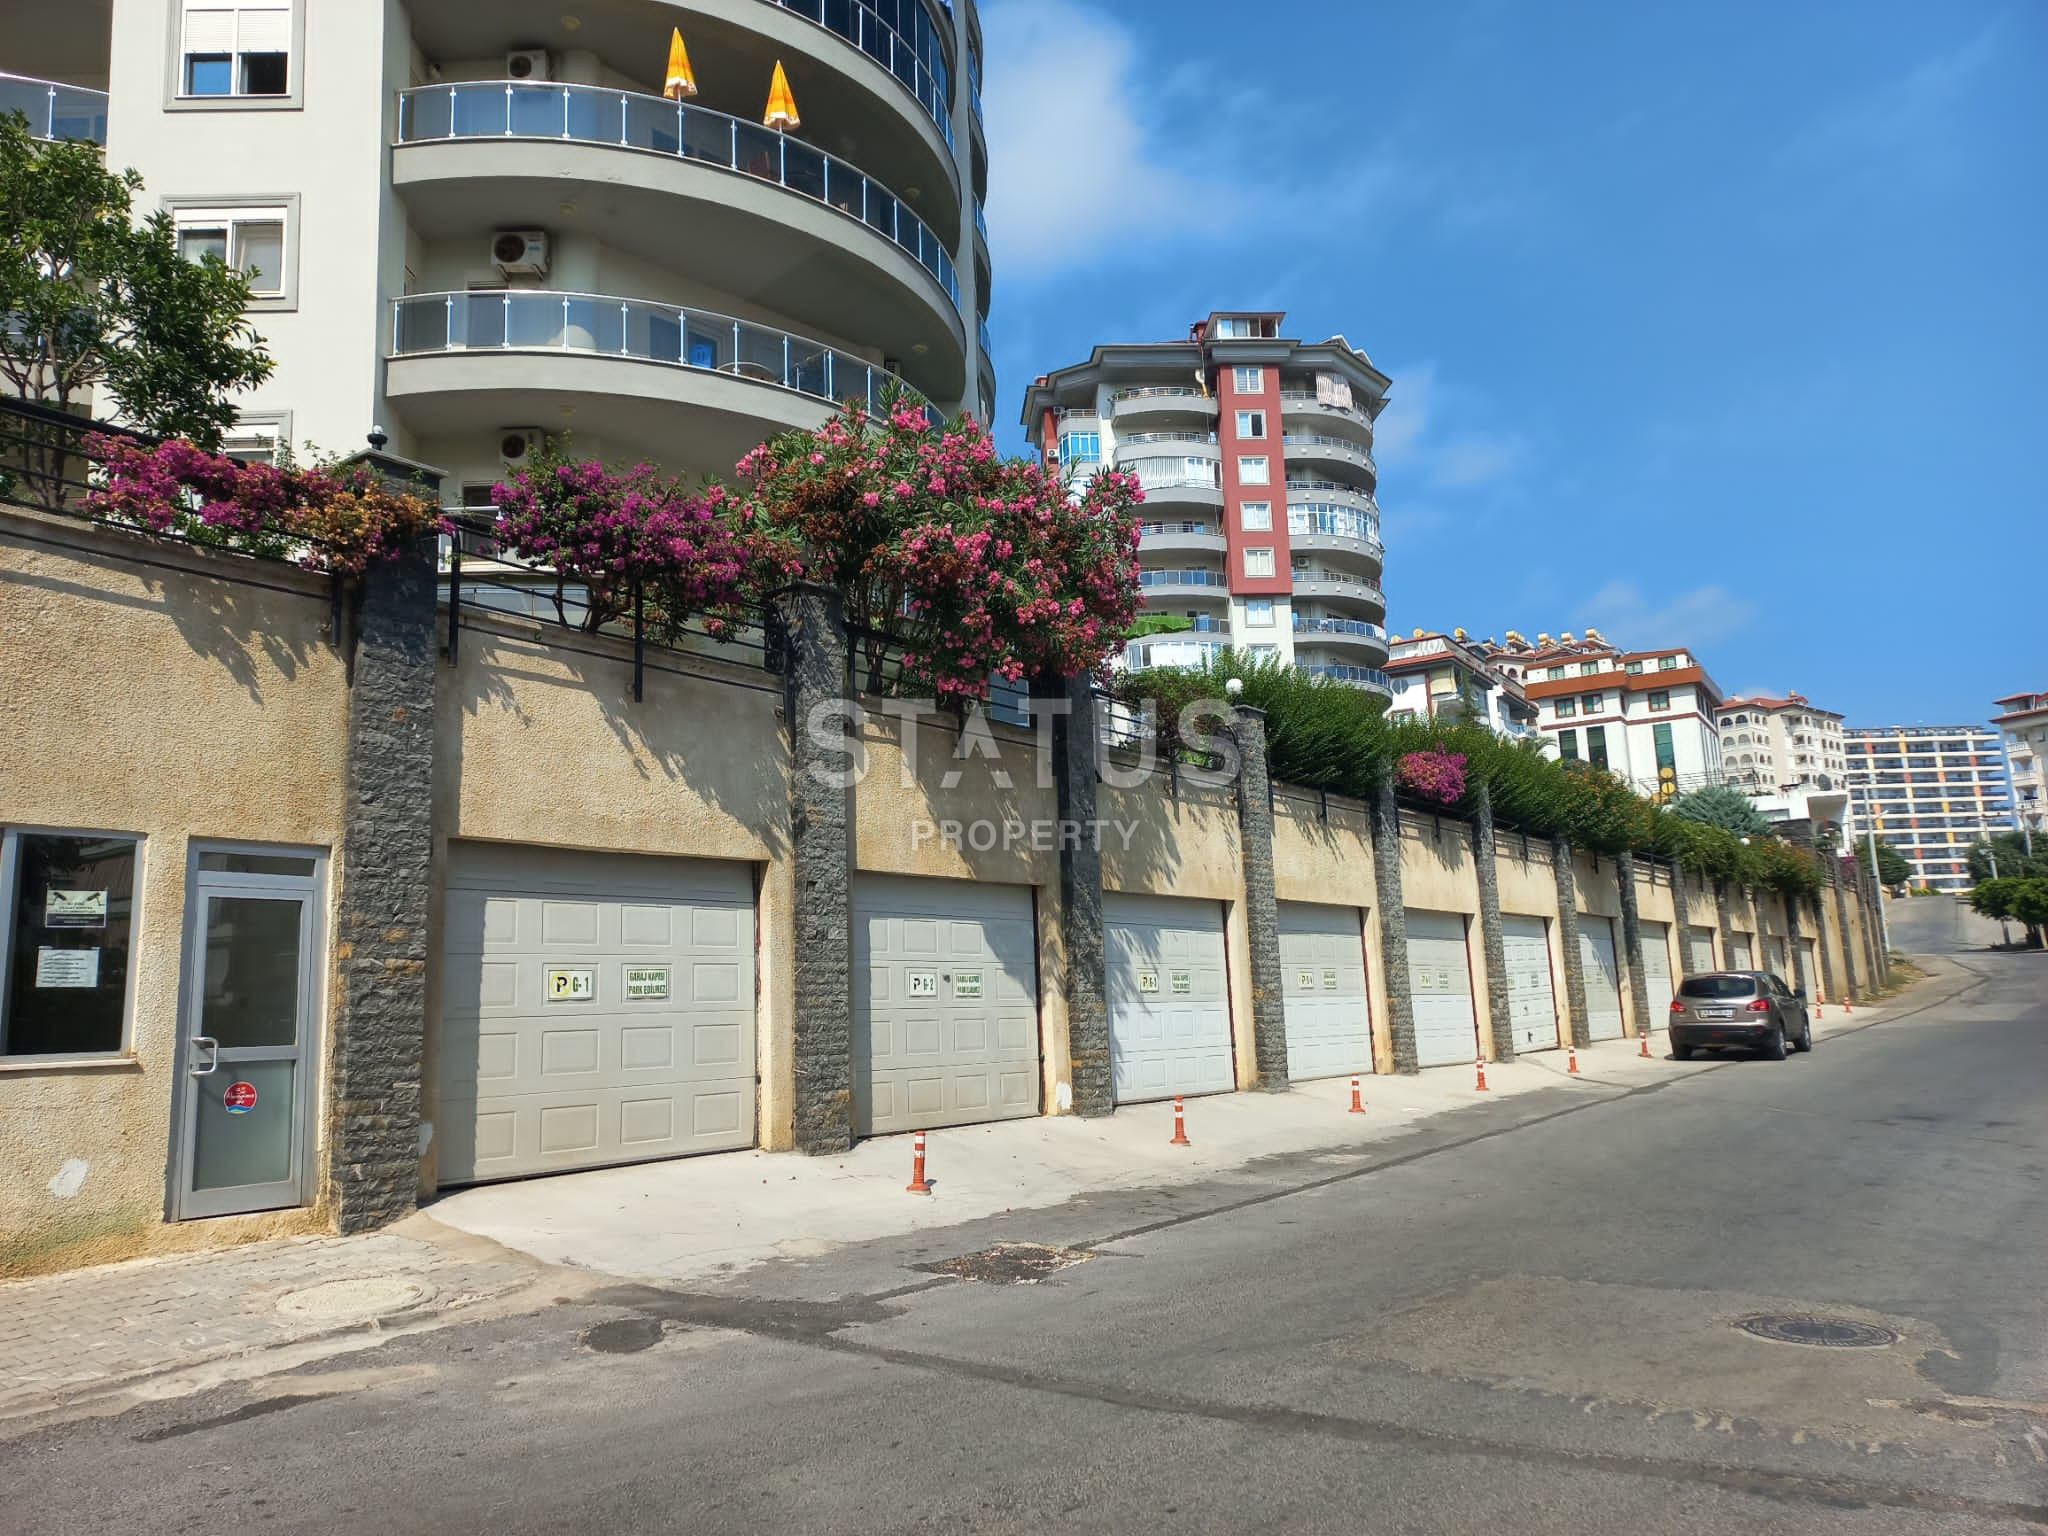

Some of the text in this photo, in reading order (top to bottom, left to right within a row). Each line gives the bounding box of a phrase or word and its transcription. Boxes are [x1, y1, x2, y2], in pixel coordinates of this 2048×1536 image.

[556, 976, 568, 993] P
[628, 985, 643, 995] PARK
[913, 977, 921, 991] P
